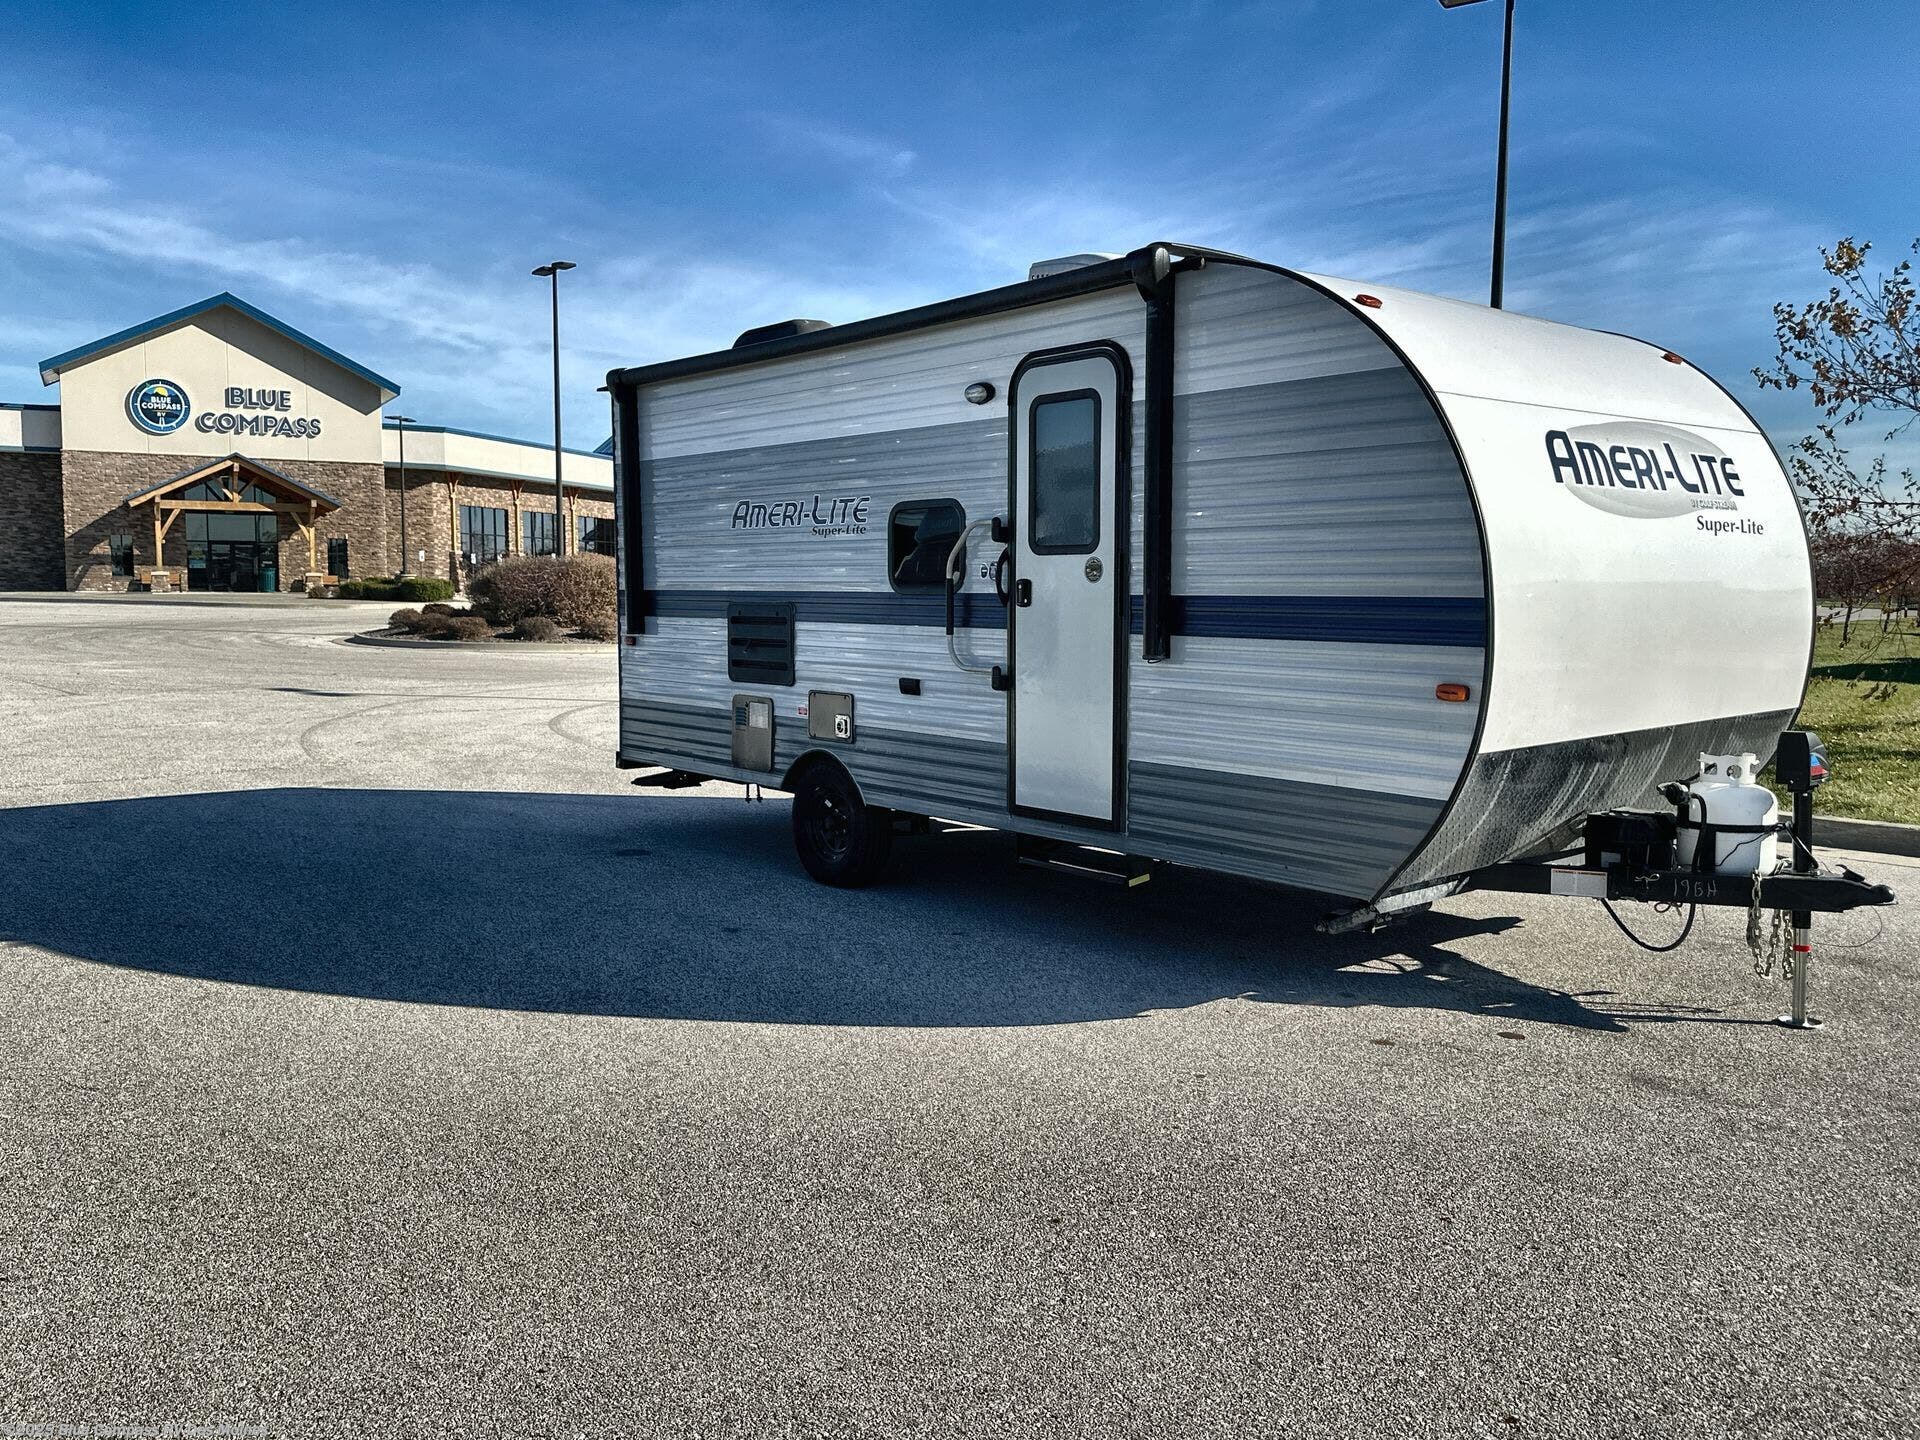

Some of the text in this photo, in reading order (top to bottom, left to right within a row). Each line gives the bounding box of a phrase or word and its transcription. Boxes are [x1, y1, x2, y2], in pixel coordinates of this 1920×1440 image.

[141, 402, 181, 410] COMPASS
[225, 387, 291, 411] BLUE
[195, 412, 321, 439] COMPASS
[1545, 430, 1745, 497] AMERI-LITE
[731, 494, 870, 529] AMERI-LITE
[811, 525, 867, 538] Super-Lite
[1696, 515, 1764, 536] Super-Lite
